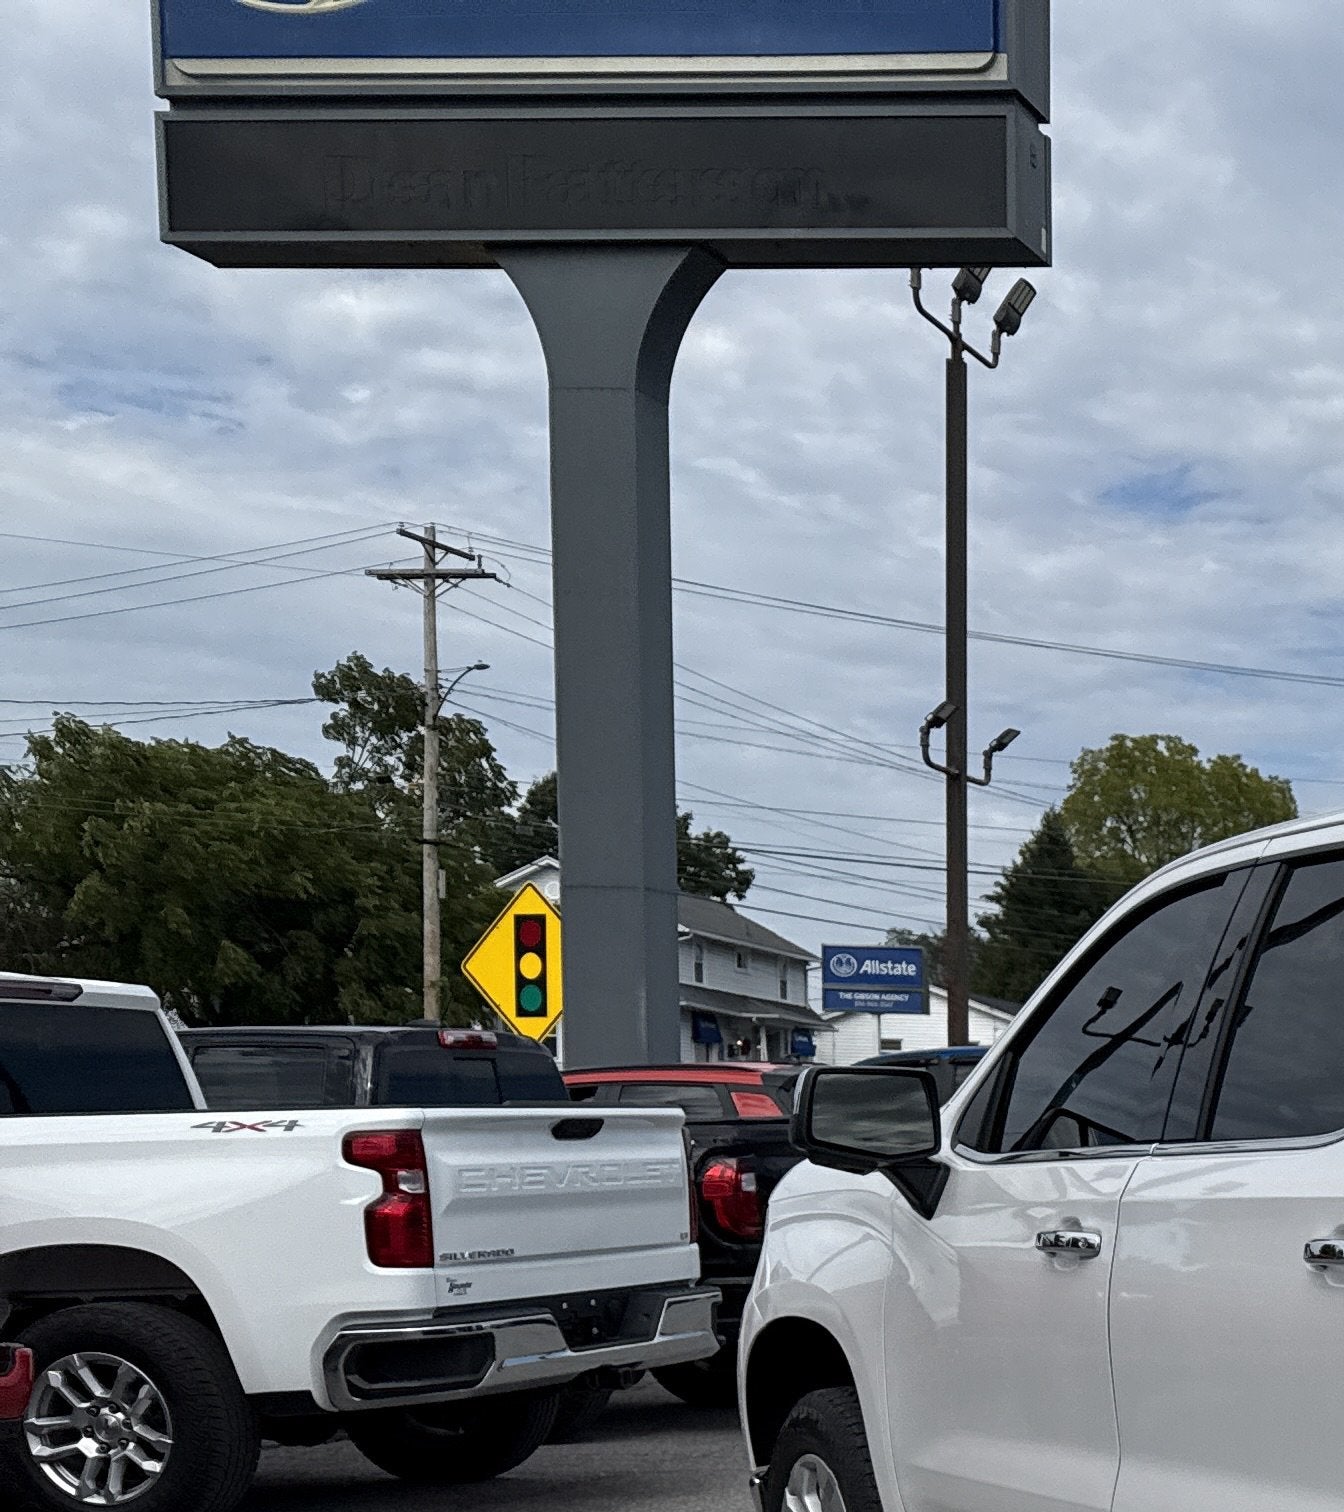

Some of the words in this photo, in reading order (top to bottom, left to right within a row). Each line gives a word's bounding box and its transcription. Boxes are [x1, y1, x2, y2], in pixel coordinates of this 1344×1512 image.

[859, 959, 916, 976] Allstate
[839, 991, 853, 1000] THE
[881, 993, 909, 1002] AGENCY
[457, 1161, 681, 1193] CHEVROLET
[439, 1248, 515, 1262] SILVERADO
